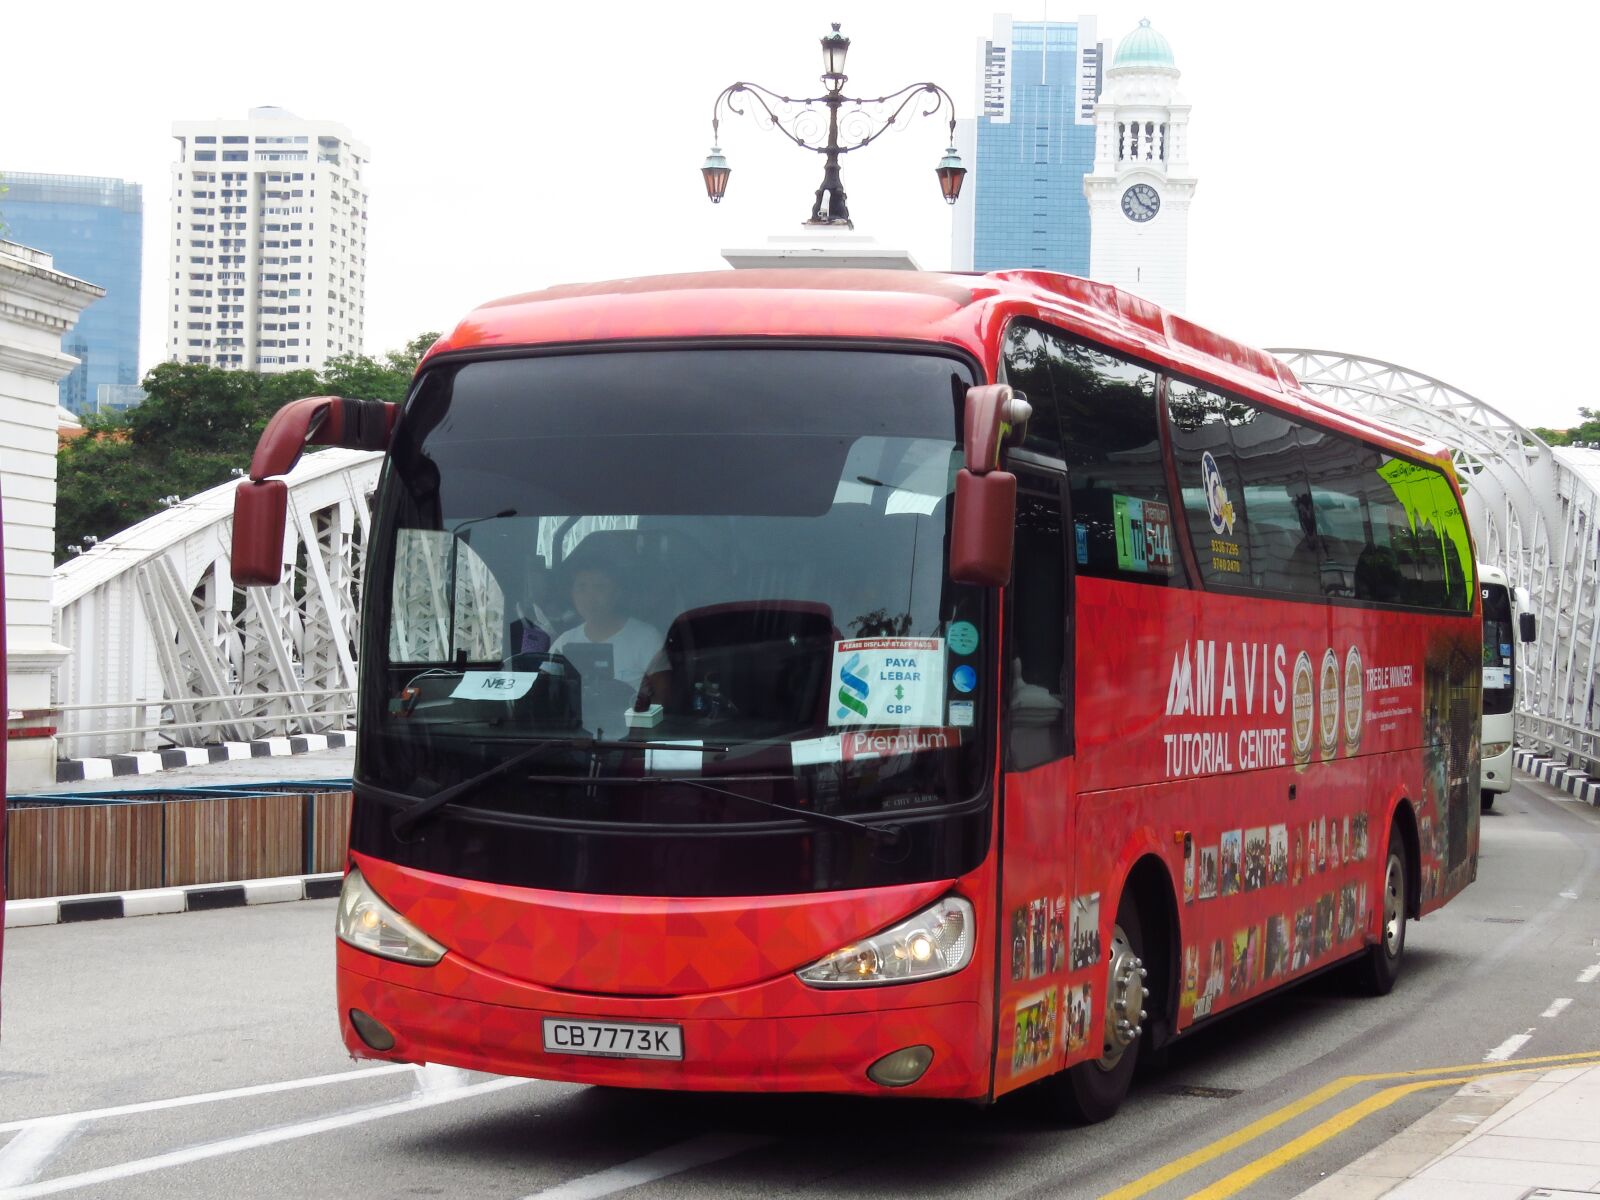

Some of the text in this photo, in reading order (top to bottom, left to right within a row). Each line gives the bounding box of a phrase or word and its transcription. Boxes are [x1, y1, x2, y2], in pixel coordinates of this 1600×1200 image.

[1145, 522, 1171, 564] 544
[880, 672, 921, 681] LEBAR
[886, 658, 917, 668] PAYA
[1197, 640, 1287, 716] MAVIS
[1366, 665, 1413, 692] TREBLE WINNER!
[886, 705, 912, 714] CBP
[854, 729, 948, 751] Premium
[1164, 728, 1287, 777] TUTORIAL CENTRE
[554, 1025, 670, 1052] CB7773K
